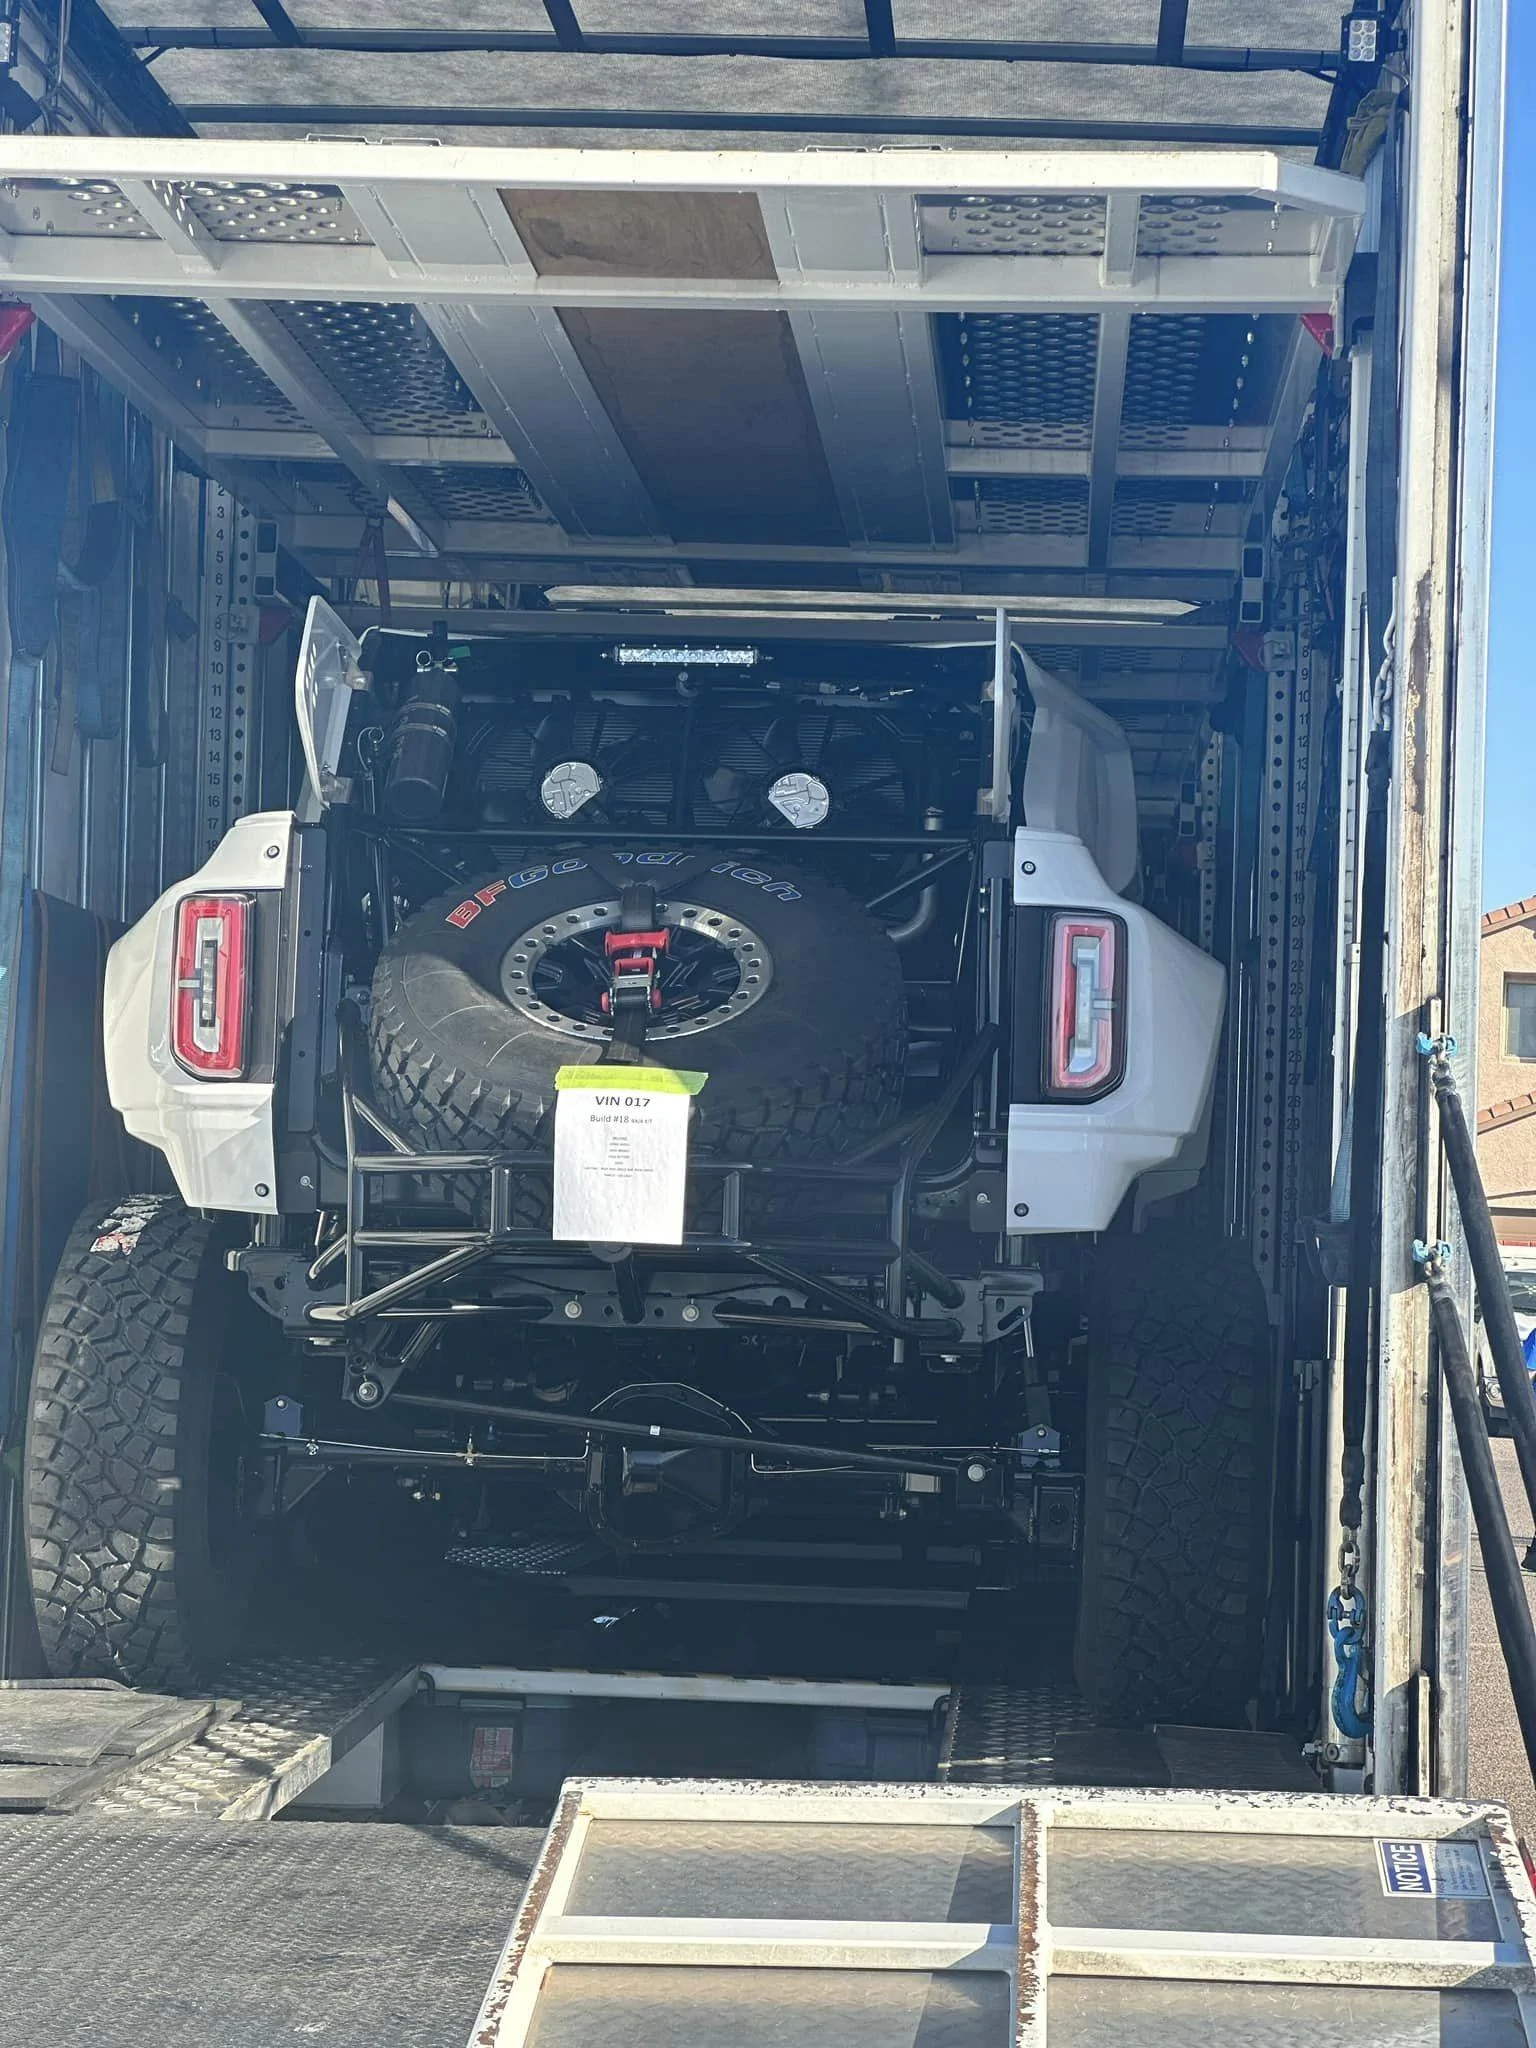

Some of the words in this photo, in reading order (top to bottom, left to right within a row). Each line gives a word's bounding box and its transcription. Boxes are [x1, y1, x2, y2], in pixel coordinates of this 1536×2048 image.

[210, 662, 224, 674] 10
[1301, 668, 1309, 680] 9
[212, 684, 222, 696] 11
[210, 706, 222, 719] 12
[209, 729, 222, 741] 13
[209, 751, 222, 763] 14
[208, 773, 220, 785] 15
[207, 795, 220, 808] 16
[207, 817, 219, 830] 17
[595, 1096, 620, 1106] VIN
[624, 1096, 650, 1107] 017
[590, 1114, 612, 1122] Build
[614, 1116, 630, 1124] #18
[1390, 1844, 1424, 1891] NOTICE
